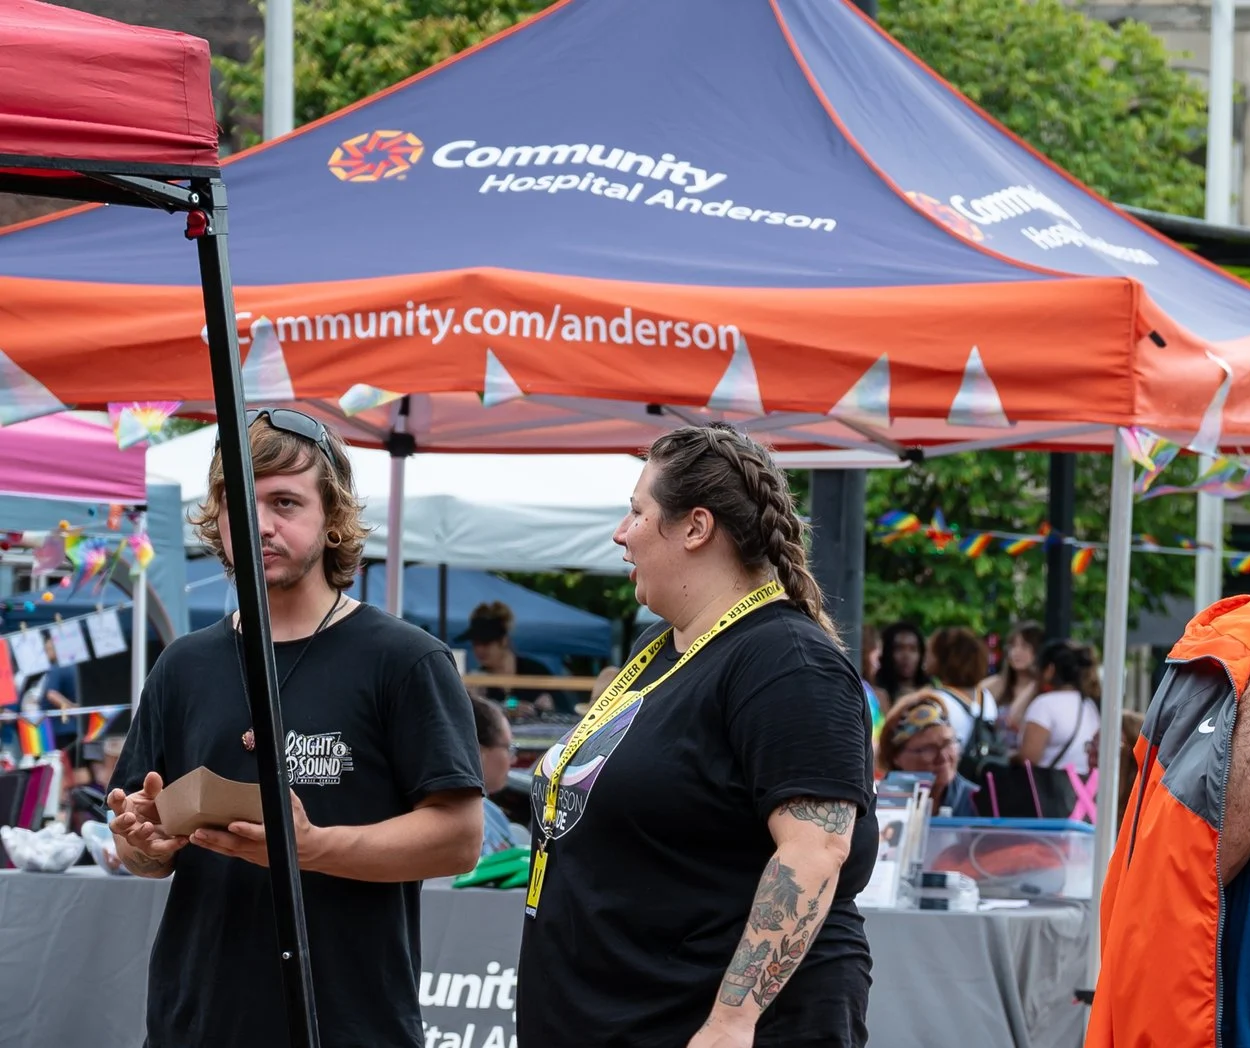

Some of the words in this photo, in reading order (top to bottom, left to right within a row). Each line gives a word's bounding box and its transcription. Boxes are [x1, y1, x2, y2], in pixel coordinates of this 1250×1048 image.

[432, 140, 727, 194] Community
[479, 171, 644, 202] Hospital
[645, 189, 838, 232] Anderson
[595, 663, 641, 712] VOLUNTEER
[296, 736, 334, 756] SIGHT
[299, 757, 341, 776] SOUND
[532, 782, 583, 813] ANRSON
